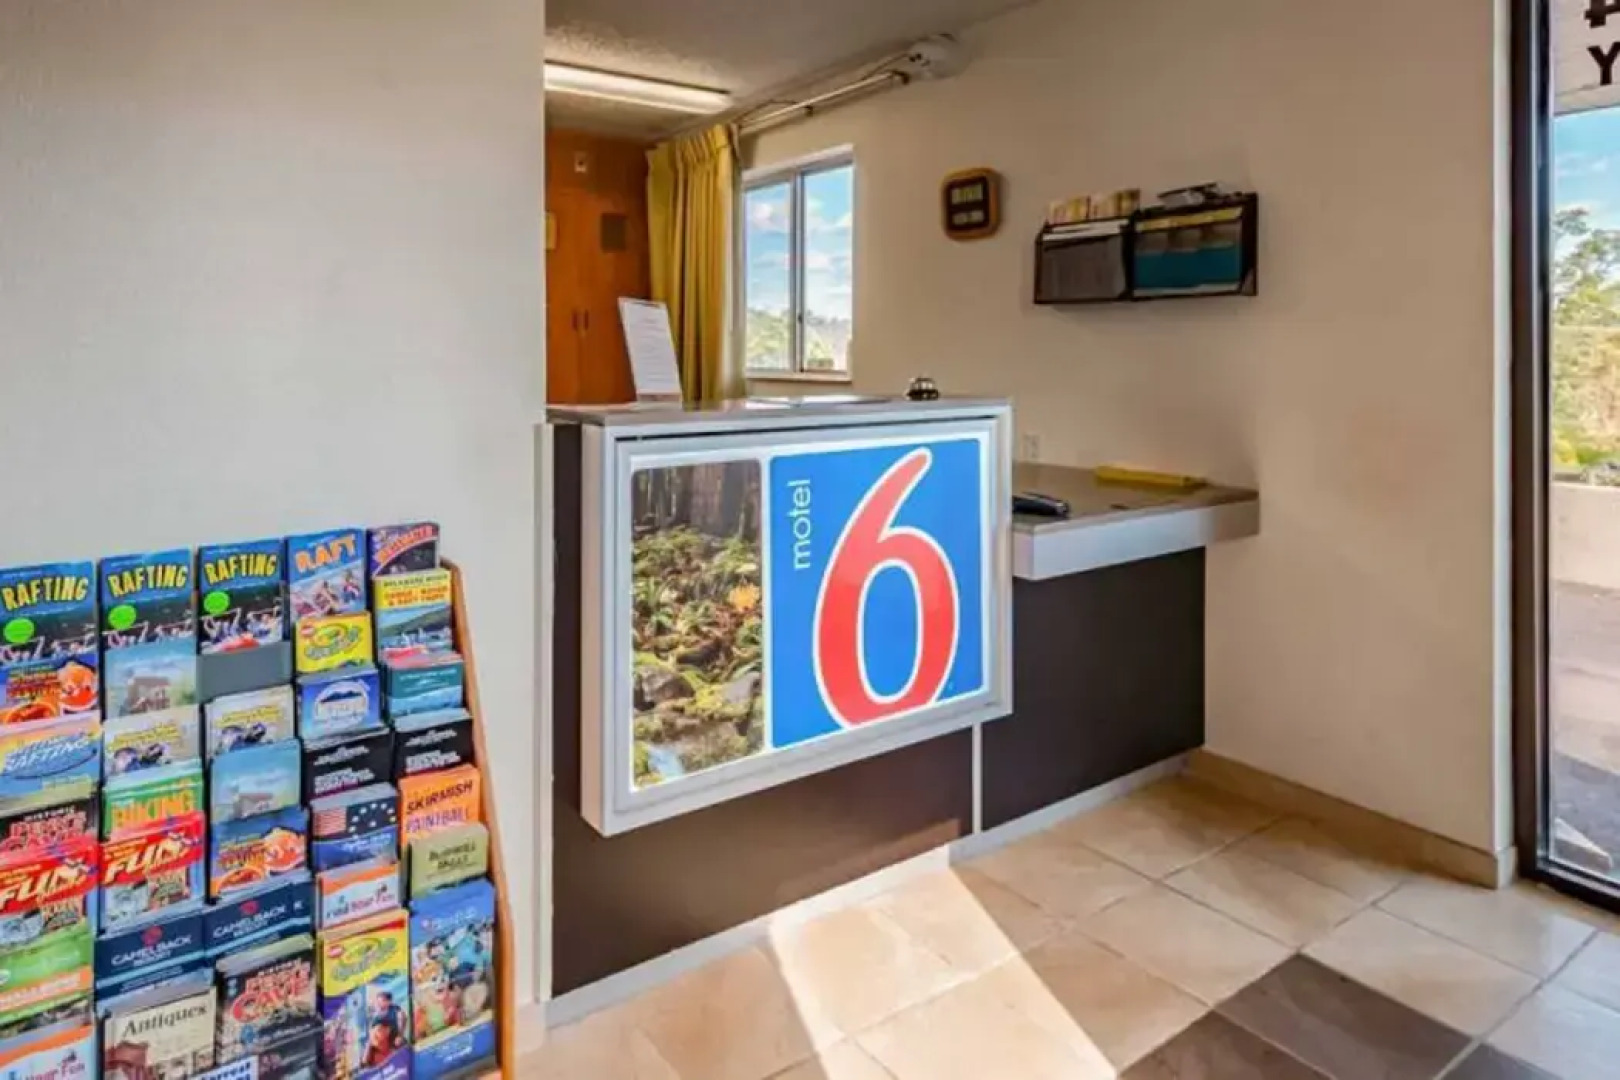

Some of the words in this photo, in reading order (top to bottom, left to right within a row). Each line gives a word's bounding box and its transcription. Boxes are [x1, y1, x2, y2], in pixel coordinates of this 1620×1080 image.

[788, 478, 811, 570] motel
[203, 552, 278, 584] RAFTING
[295, 536, 356, 573] RAFT
[1, 576, 89, 611] RAFTING
[107, 565, 188, 597] RAFTING
[812, 447, 961, 732] 6
[407, 780, 473, 815] SKIRMISH
[123, 1004, 207, 1037] Antiques
